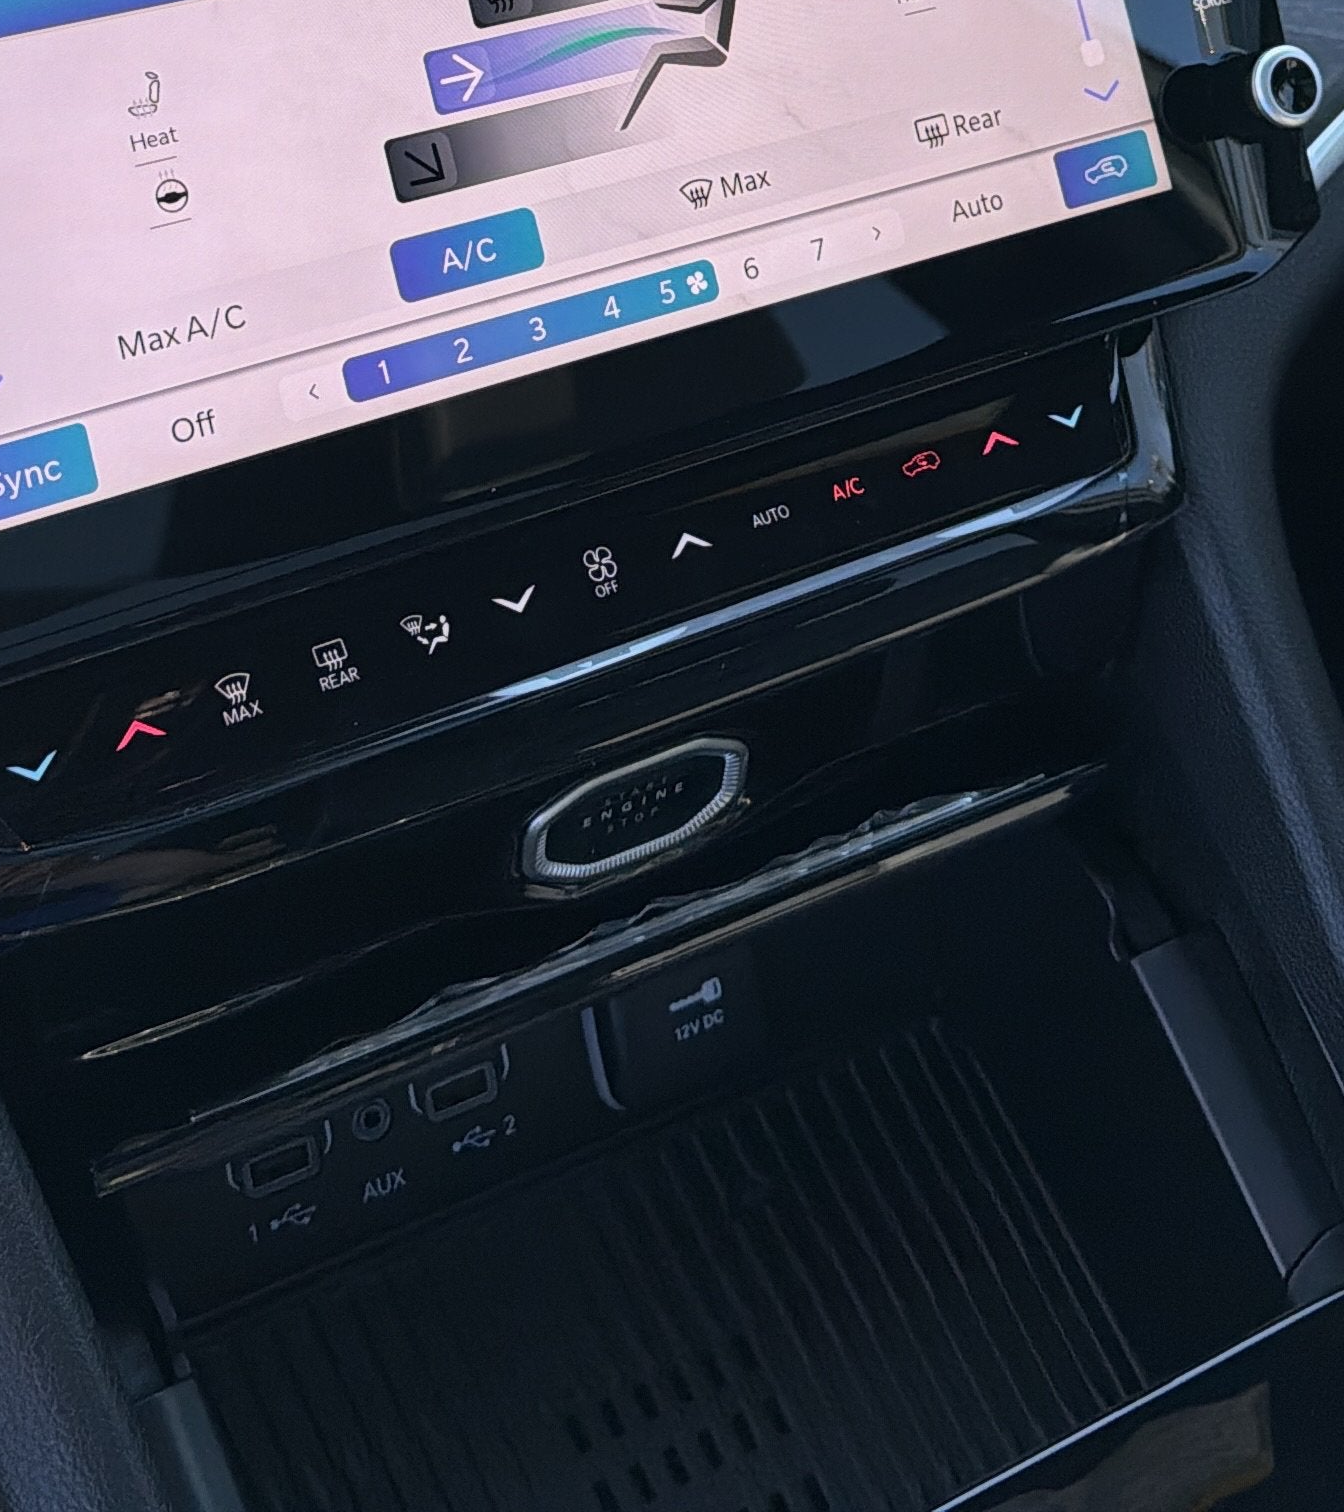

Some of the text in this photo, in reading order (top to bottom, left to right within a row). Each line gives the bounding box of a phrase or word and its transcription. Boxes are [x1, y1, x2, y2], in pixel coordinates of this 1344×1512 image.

[953, 106, 1002, 138] Rear
[129, 127, 179, 153] Heat
[719, 169, 772, 200] Max
[951, 192, 1004, 223] Auto
[441, 237, 498, 275] A/C
[377, 238, 825, 385] 1 2 3 4 5 6 7
[117, 304, 248, 361] Max A/C
[170, 409, 217, 445] Off
[831, 477, 867, 504] A/C
[751, 503, 791, 530] AUTO
[594, 578, 620, 599] OFF
[317, 665, 361, 692] REAR
[221, 701, 264, 727] MAX
[582, 781, 684, 828] ENGINE
[674, 1008, 724, 1041] 12V DC
[503, 1114, 517, 1137] 2
[362, 1167, 406, 1204] AUX
